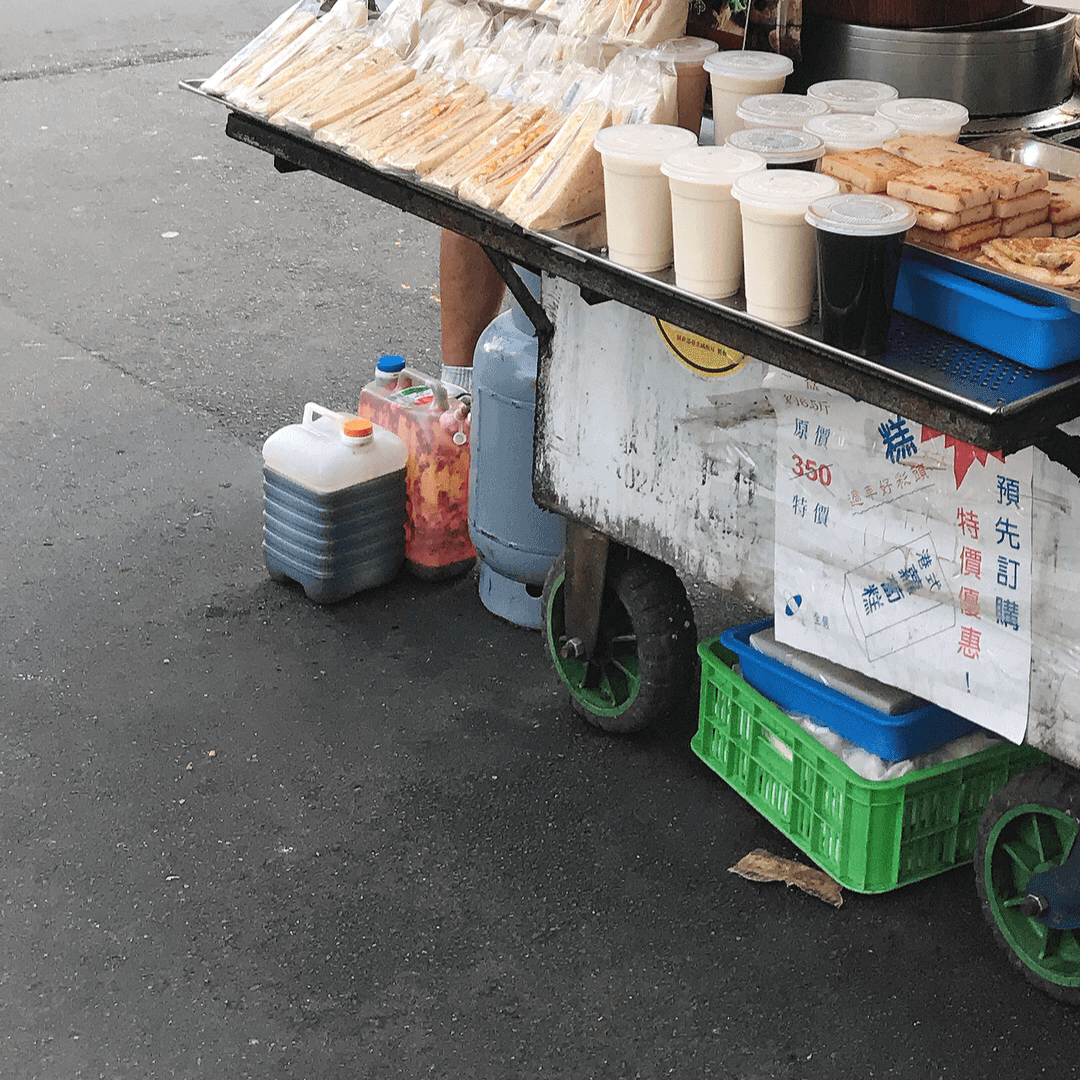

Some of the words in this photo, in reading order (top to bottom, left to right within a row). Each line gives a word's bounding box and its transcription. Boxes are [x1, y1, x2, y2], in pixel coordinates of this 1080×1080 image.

[793, 417, 831, 449] 原價
[792, 453, 832, 487] 350
[792, 494, 830, 527] 特價
[995, 474, 1021, 632] 預先訂購
